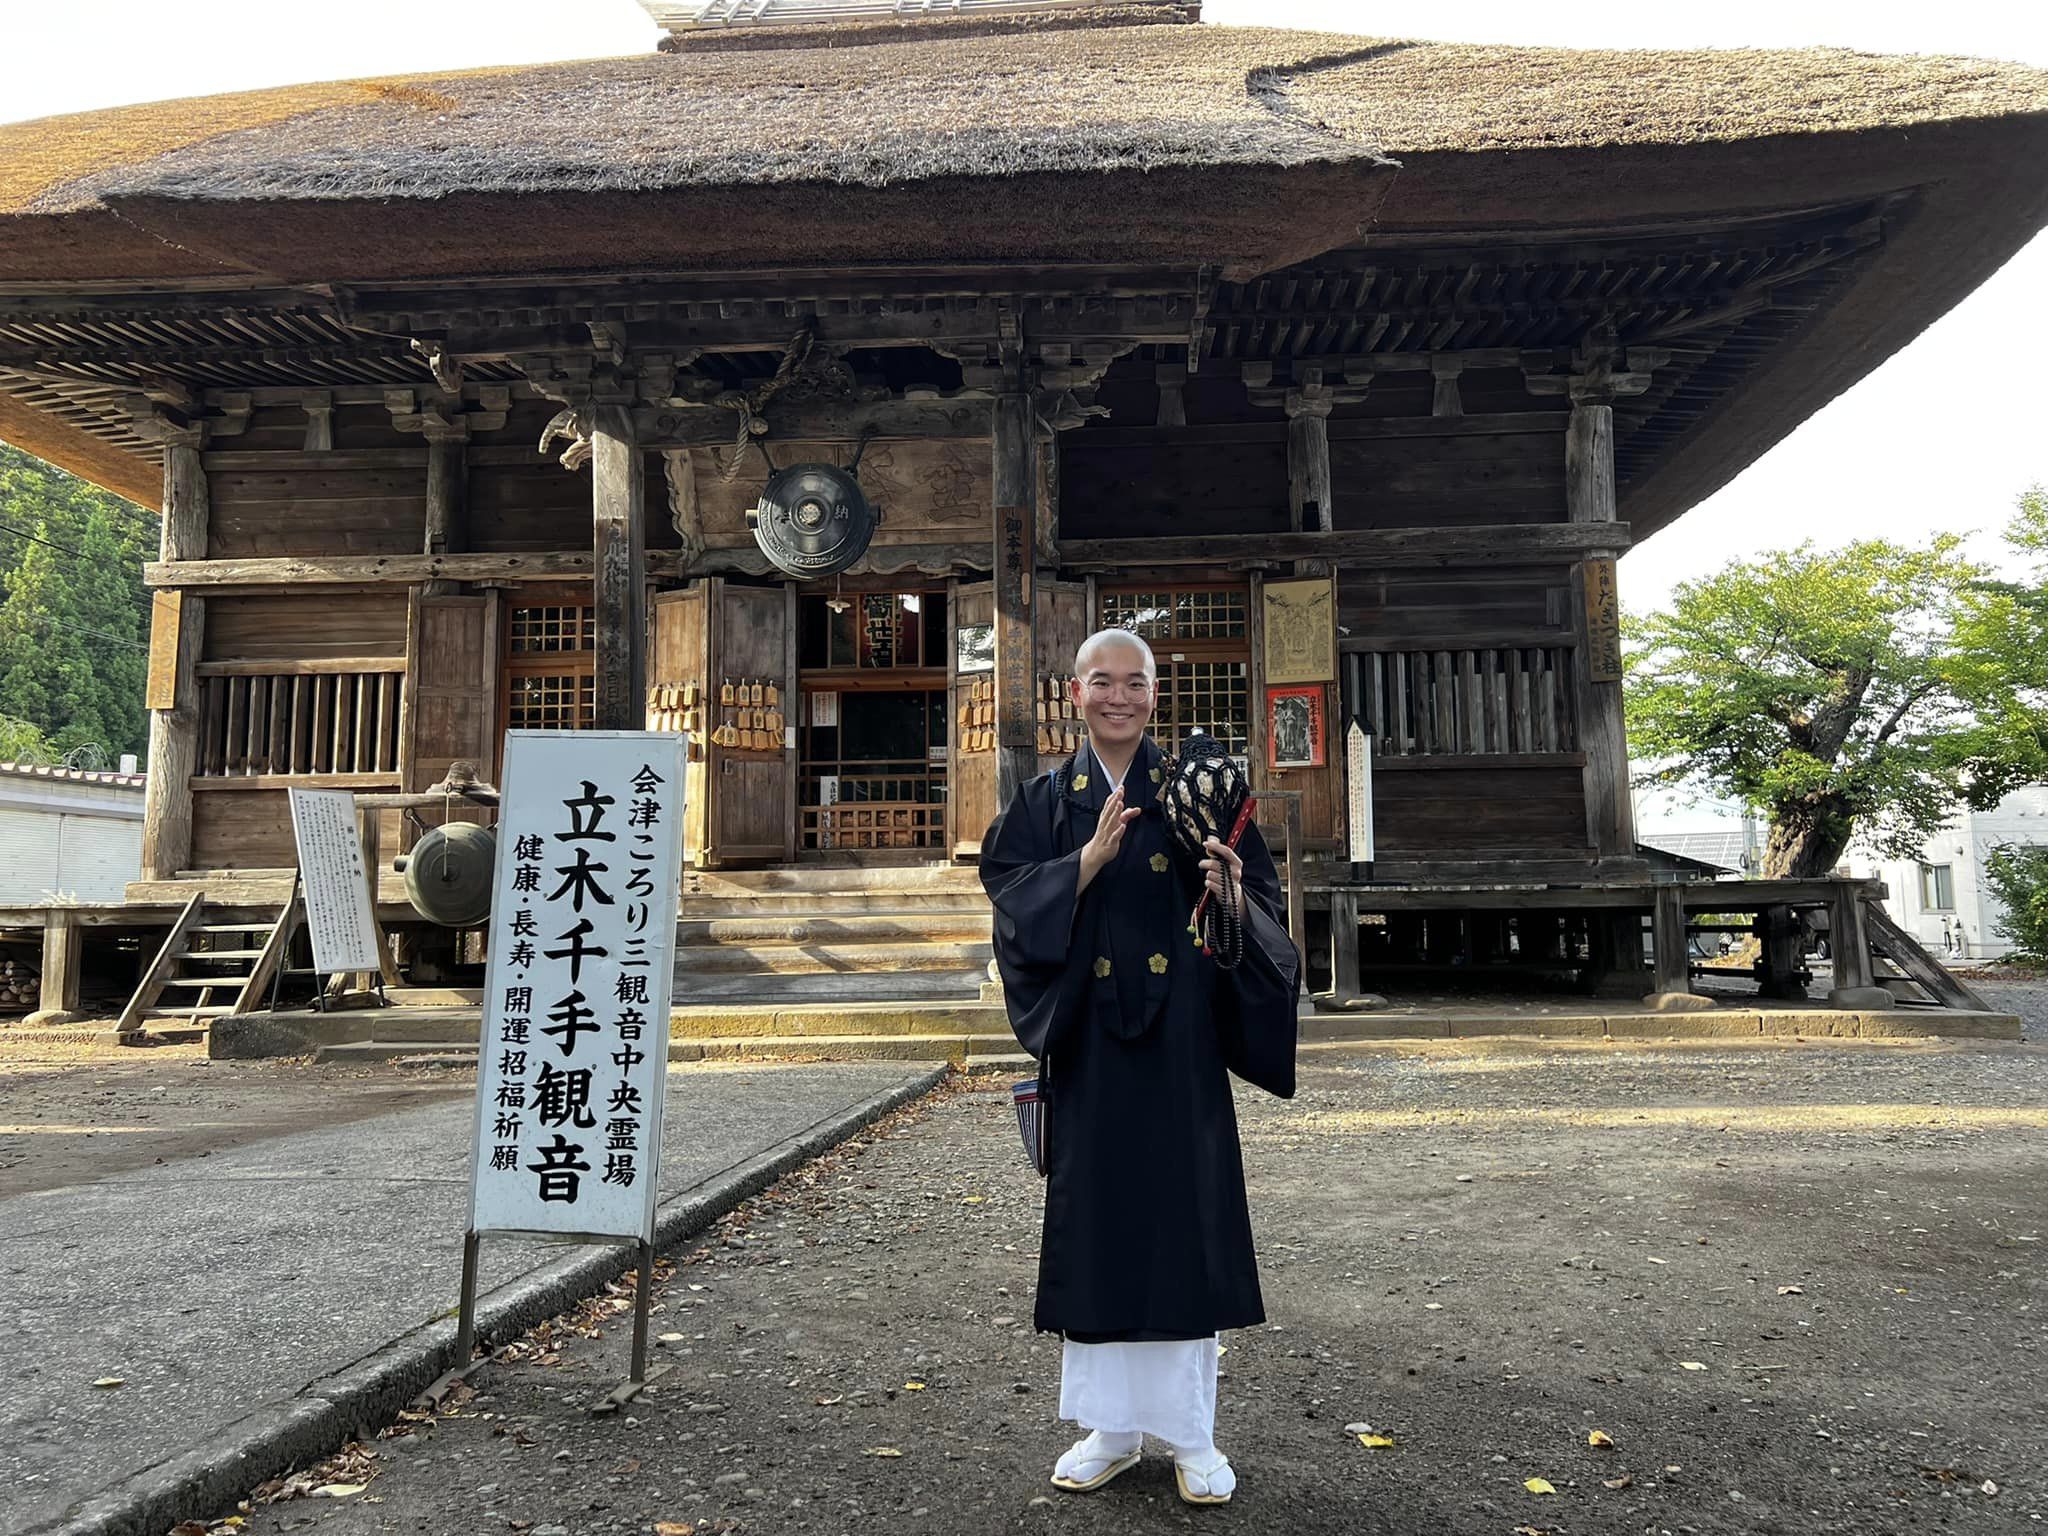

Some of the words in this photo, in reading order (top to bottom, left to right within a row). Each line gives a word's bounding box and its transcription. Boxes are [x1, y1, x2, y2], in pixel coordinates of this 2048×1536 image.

[489, 834, 545, 1172] 健康・長寿・開運招福祈願
[526, 779, 617, 1205] 立木千手観音
[601, 763, 666, 1188] 会津ころり三観音中央霊場
